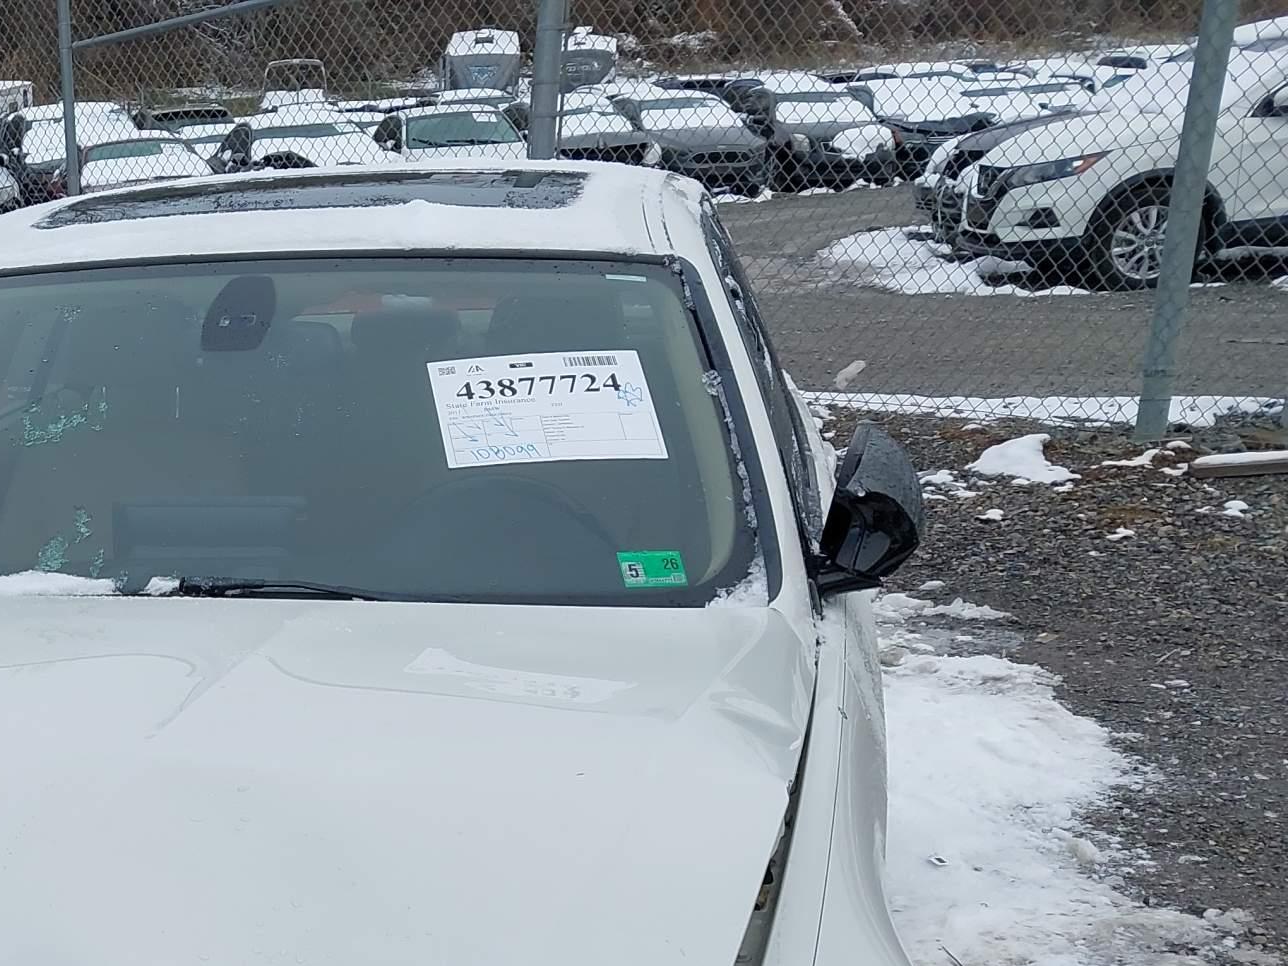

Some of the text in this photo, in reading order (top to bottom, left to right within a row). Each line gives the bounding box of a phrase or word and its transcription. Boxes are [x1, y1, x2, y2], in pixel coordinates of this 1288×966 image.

[456, 372, 621, 400] 43877724
[628, 558, 679, 578] 5 26
